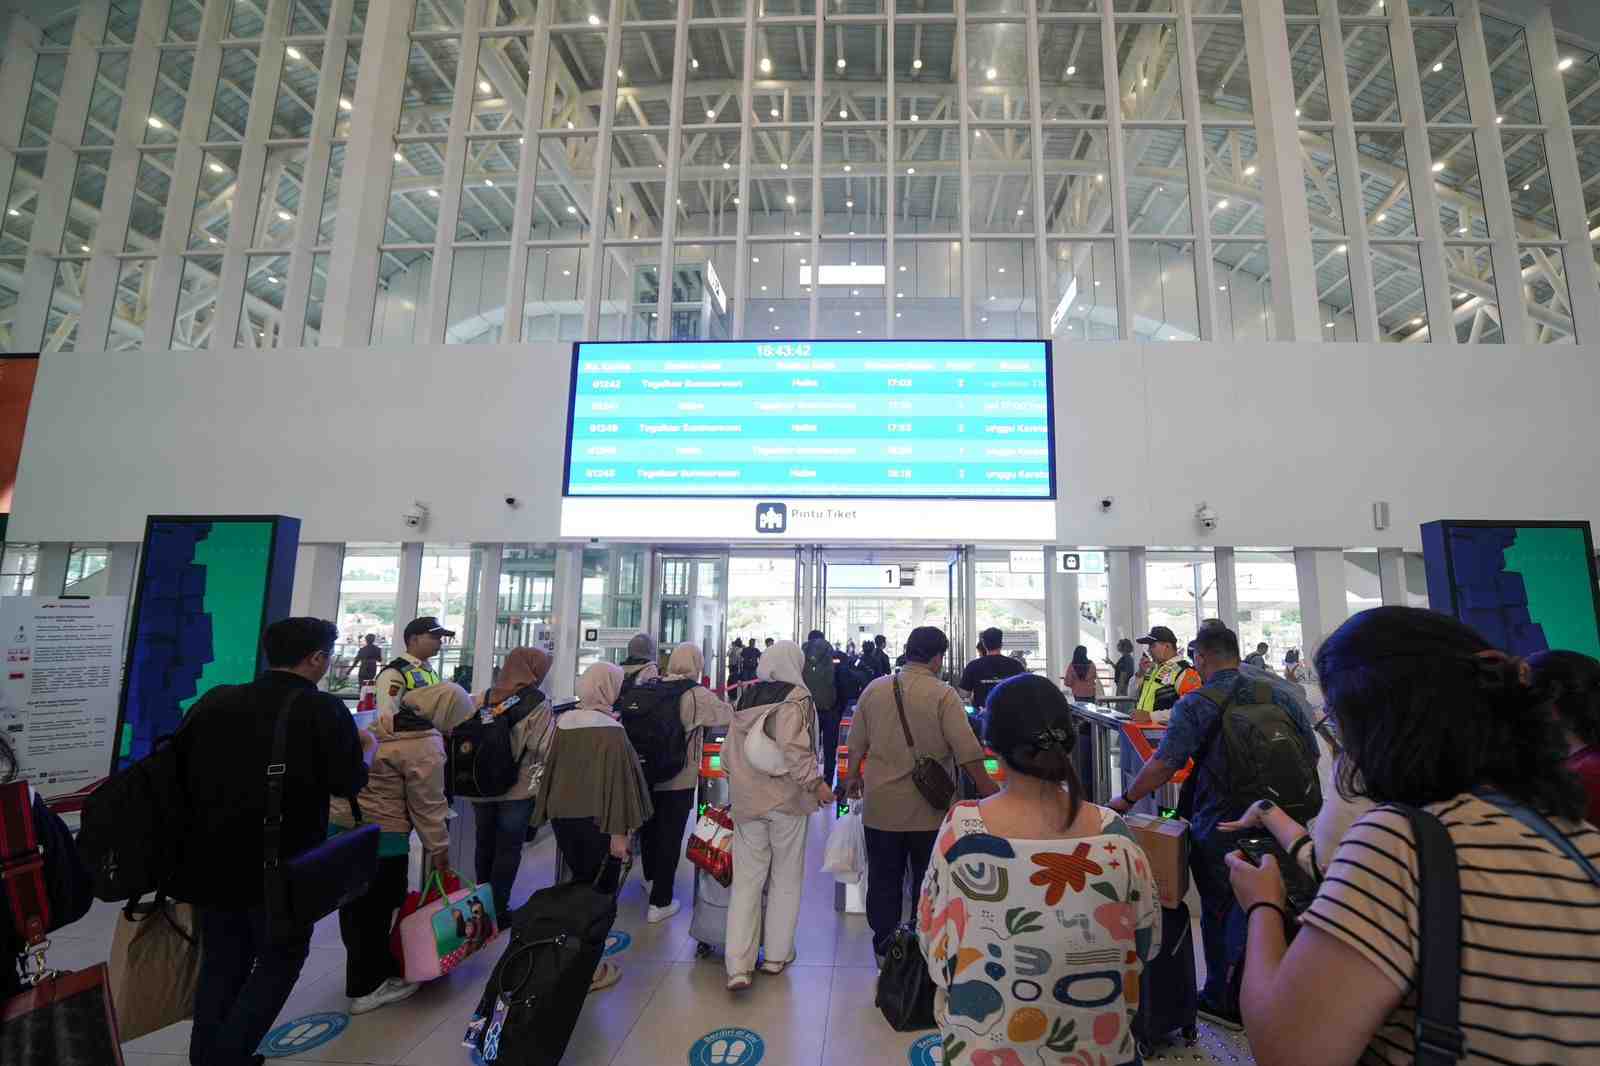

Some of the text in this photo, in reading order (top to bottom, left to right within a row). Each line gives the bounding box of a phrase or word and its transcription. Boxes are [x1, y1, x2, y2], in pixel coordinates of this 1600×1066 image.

[791, 509, 857, 519] Pintu Tiket
[885, 569, 893, 584] 1
